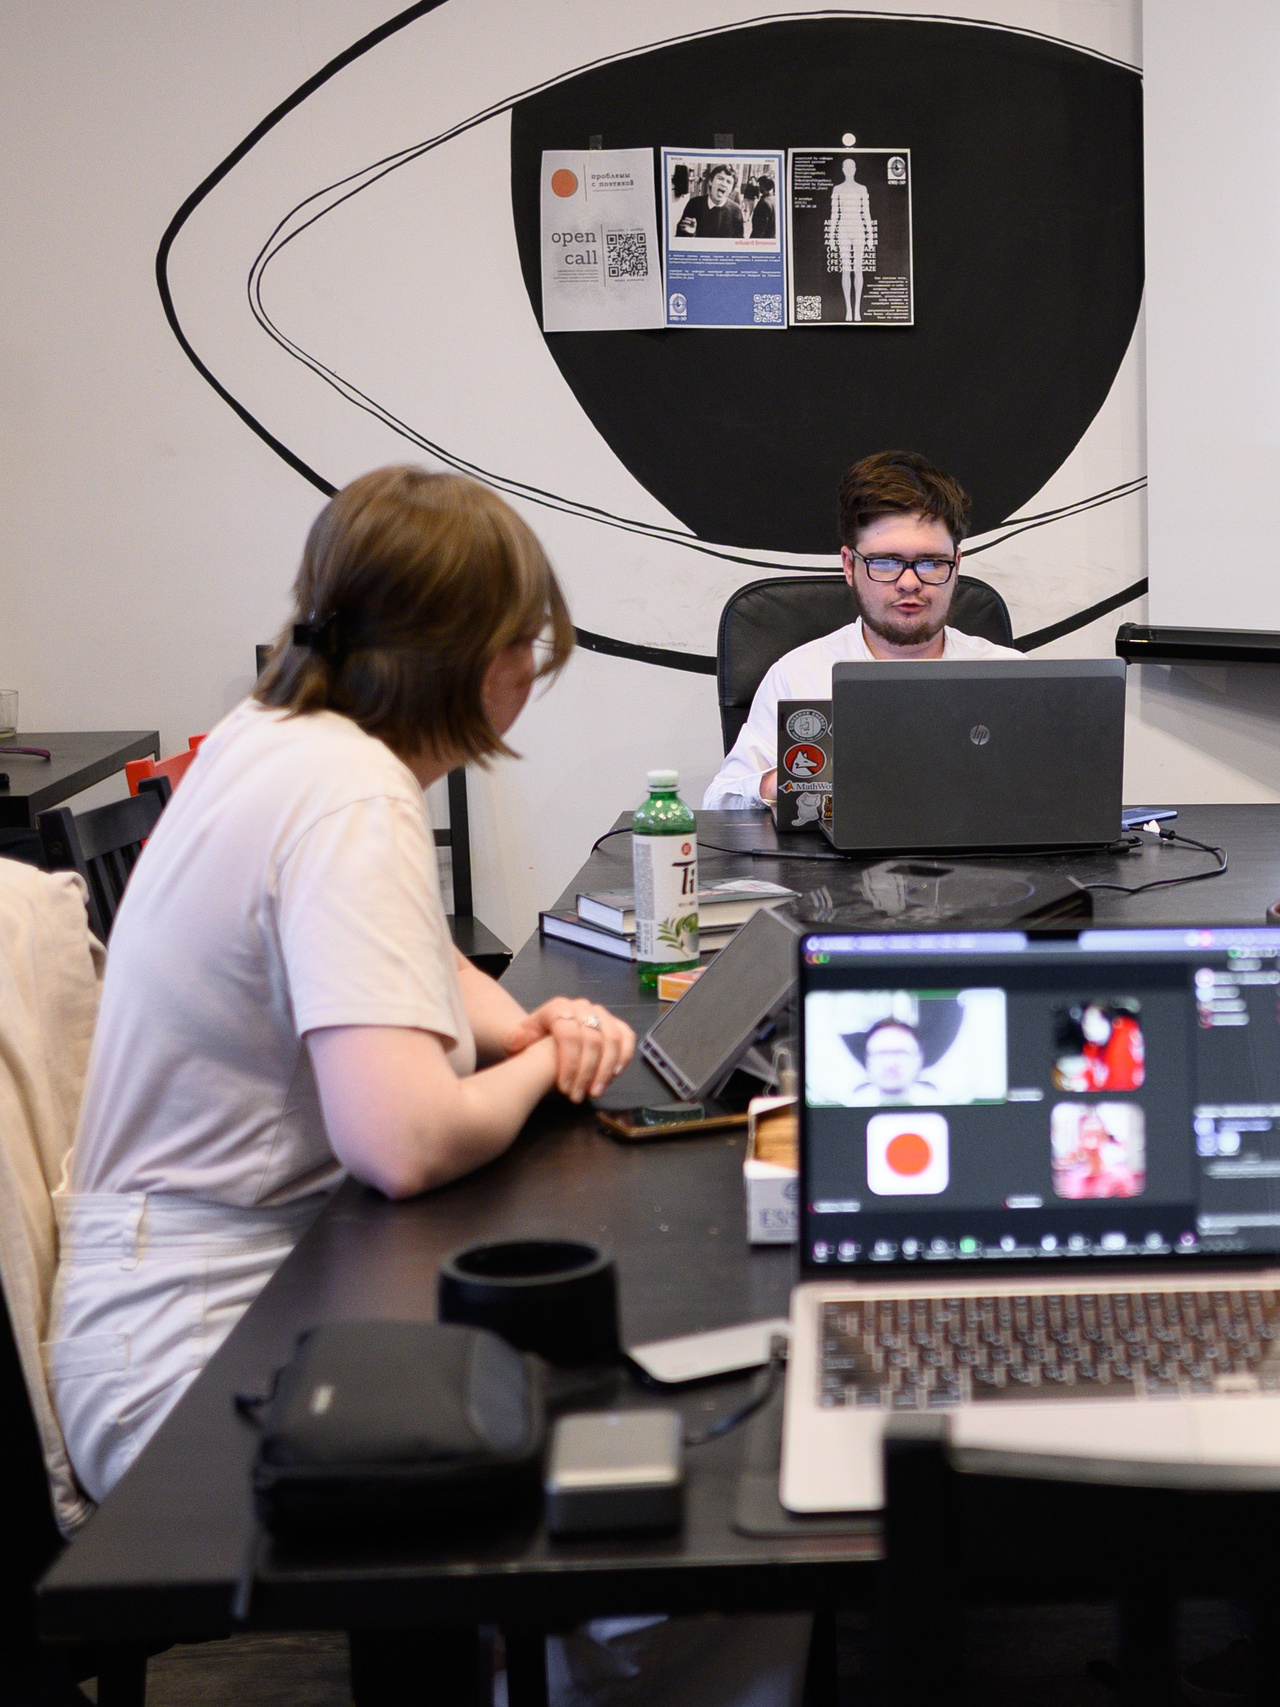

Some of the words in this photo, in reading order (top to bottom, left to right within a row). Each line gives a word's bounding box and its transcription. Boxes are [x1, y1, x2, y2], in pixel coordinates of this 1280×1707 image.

[591, 172, 630, 180] проблемы
[551, 232, 597, 247] open
[564, 250, 598, 265] call
